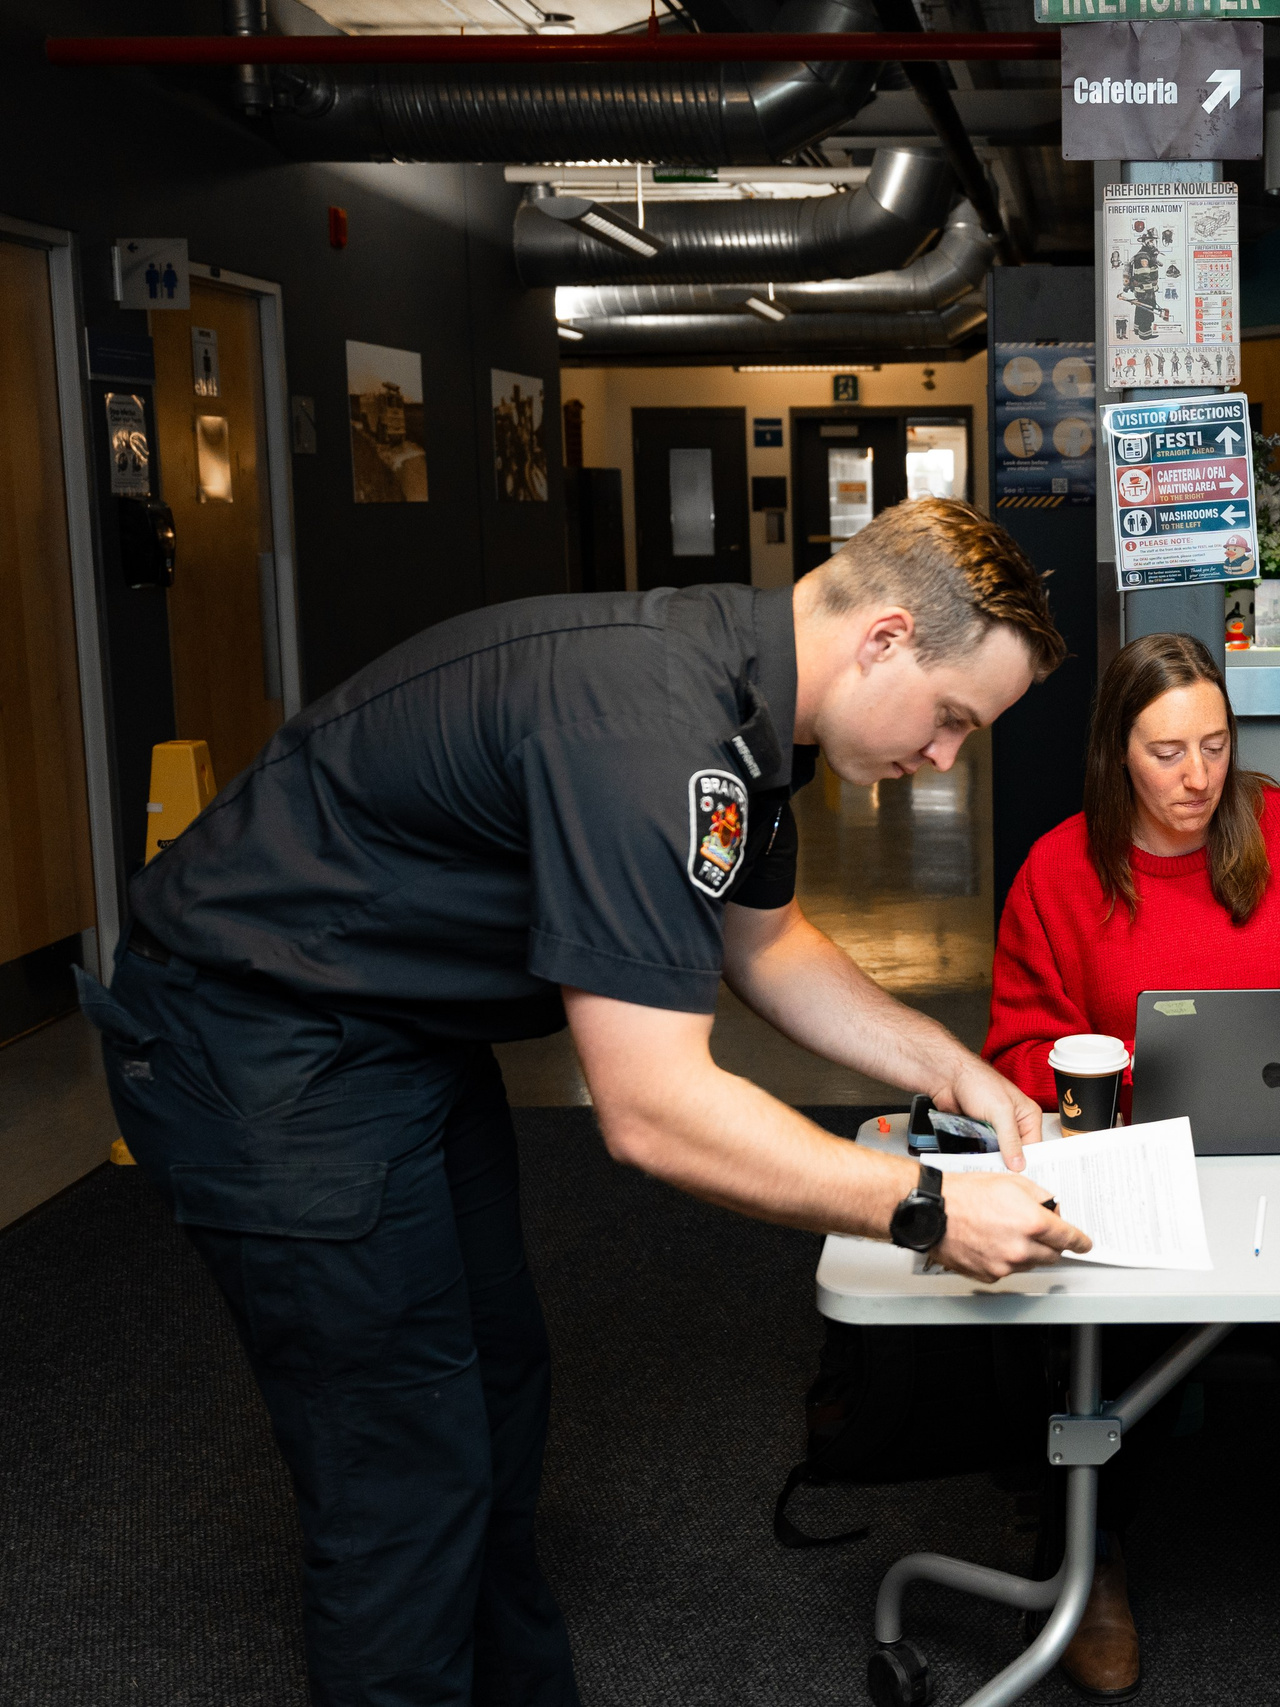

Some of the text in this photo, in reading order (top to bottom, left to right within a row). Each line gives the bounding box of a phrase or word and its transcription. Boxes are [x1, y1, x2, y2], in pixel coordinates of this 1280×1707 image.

[1073, 77, 1178, 104] Cafeteria
[1105, 182, 1239, 197] FIREFIGHTER KNOWLEDGE
[1108, 204, 1183, 214] FIREFIGHTER ANATOMY
[1117, 405, 1241, 426] VISITOR DIRECTIONS
[1155, 431, 1203, 449] FESTI
[1156, 447, 1215, 458] STRAIGHT AHEAD
[1157, 468, 1202, 483] CAFETERIA
[1207, 466, 1227, 480] OFAI
[1158, 481, 1217, 495] WAITING AREA
[1160, 508, 1219, 522] WASHROOMS
[1139, 537, 1193, 547] PLEASE NOTE:
